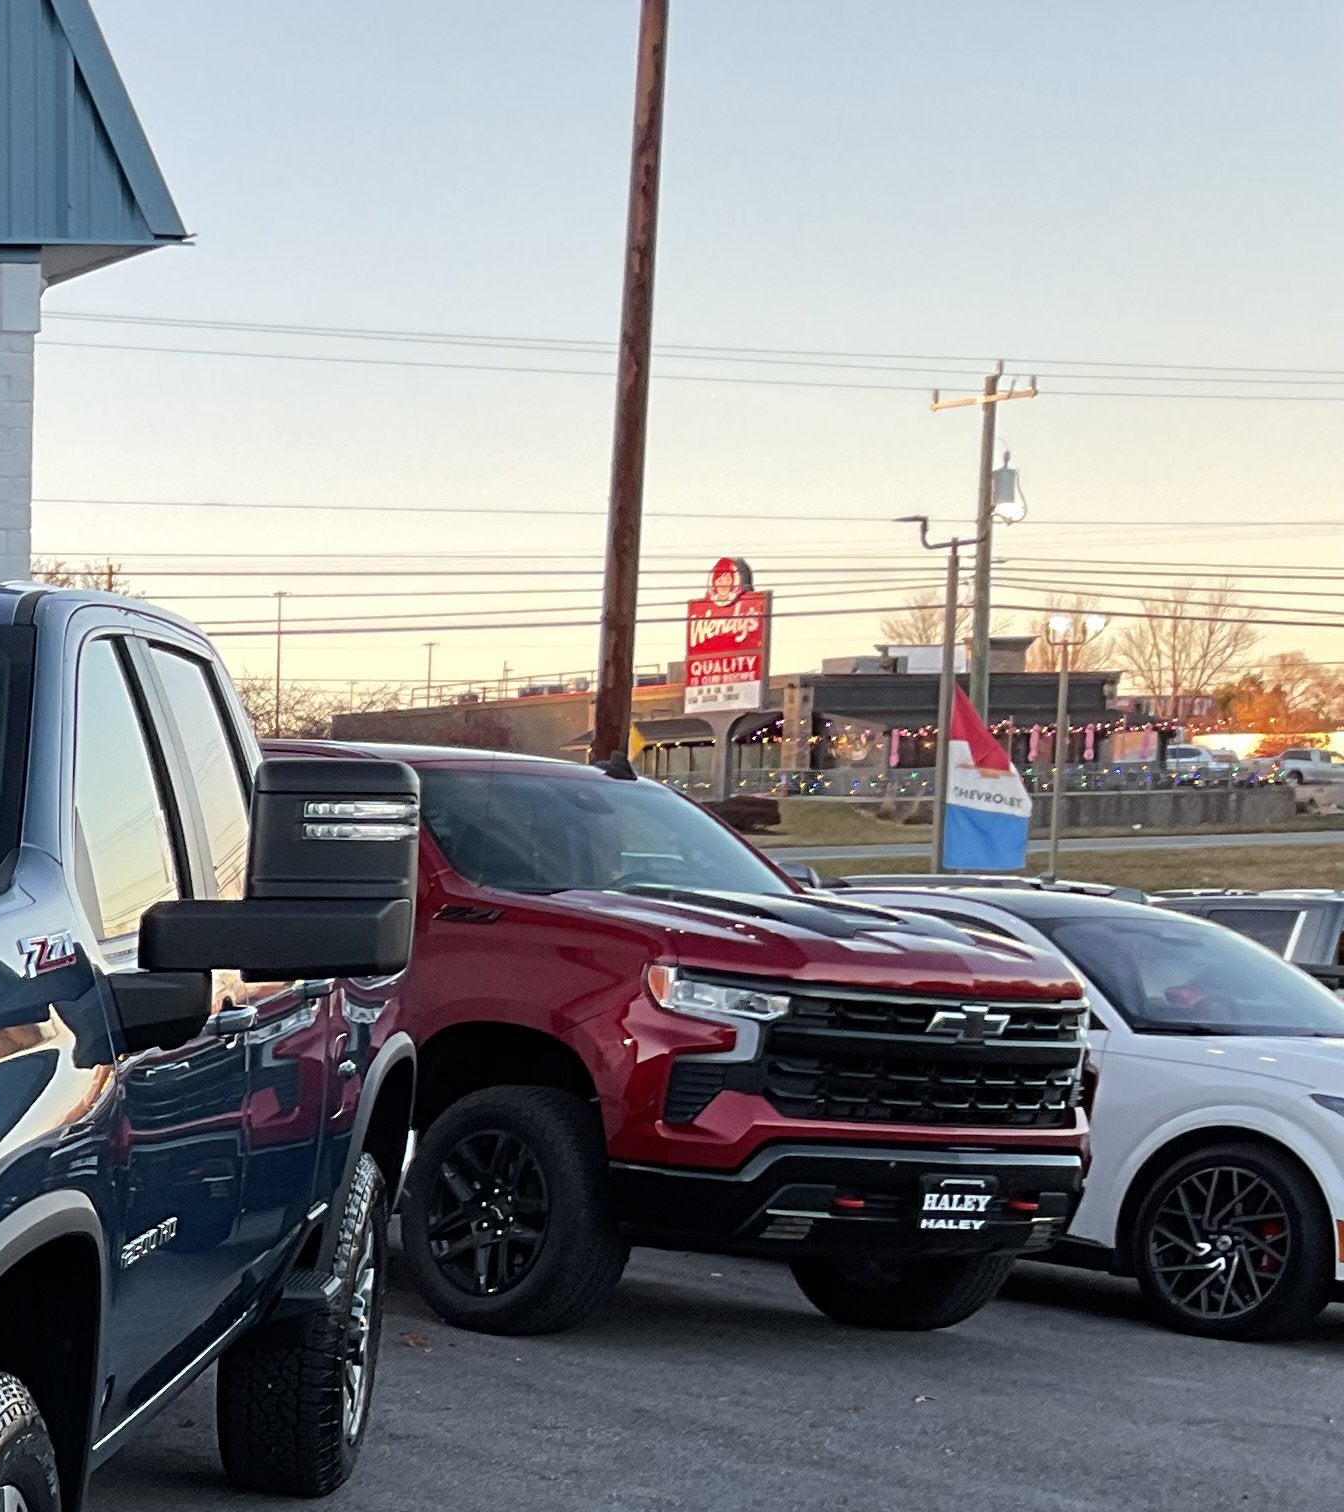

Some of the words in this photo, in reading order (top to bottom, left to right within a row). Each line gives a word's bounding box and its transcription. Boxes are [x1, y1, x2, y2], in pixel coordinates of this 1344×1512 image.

[690, 602, 759, 647] Wendy's
[690, 656, 757, 676] QUALITY
[922, 1193, 993, 1212] HALEY
[920, 1218, 986, 1230] HALEY
